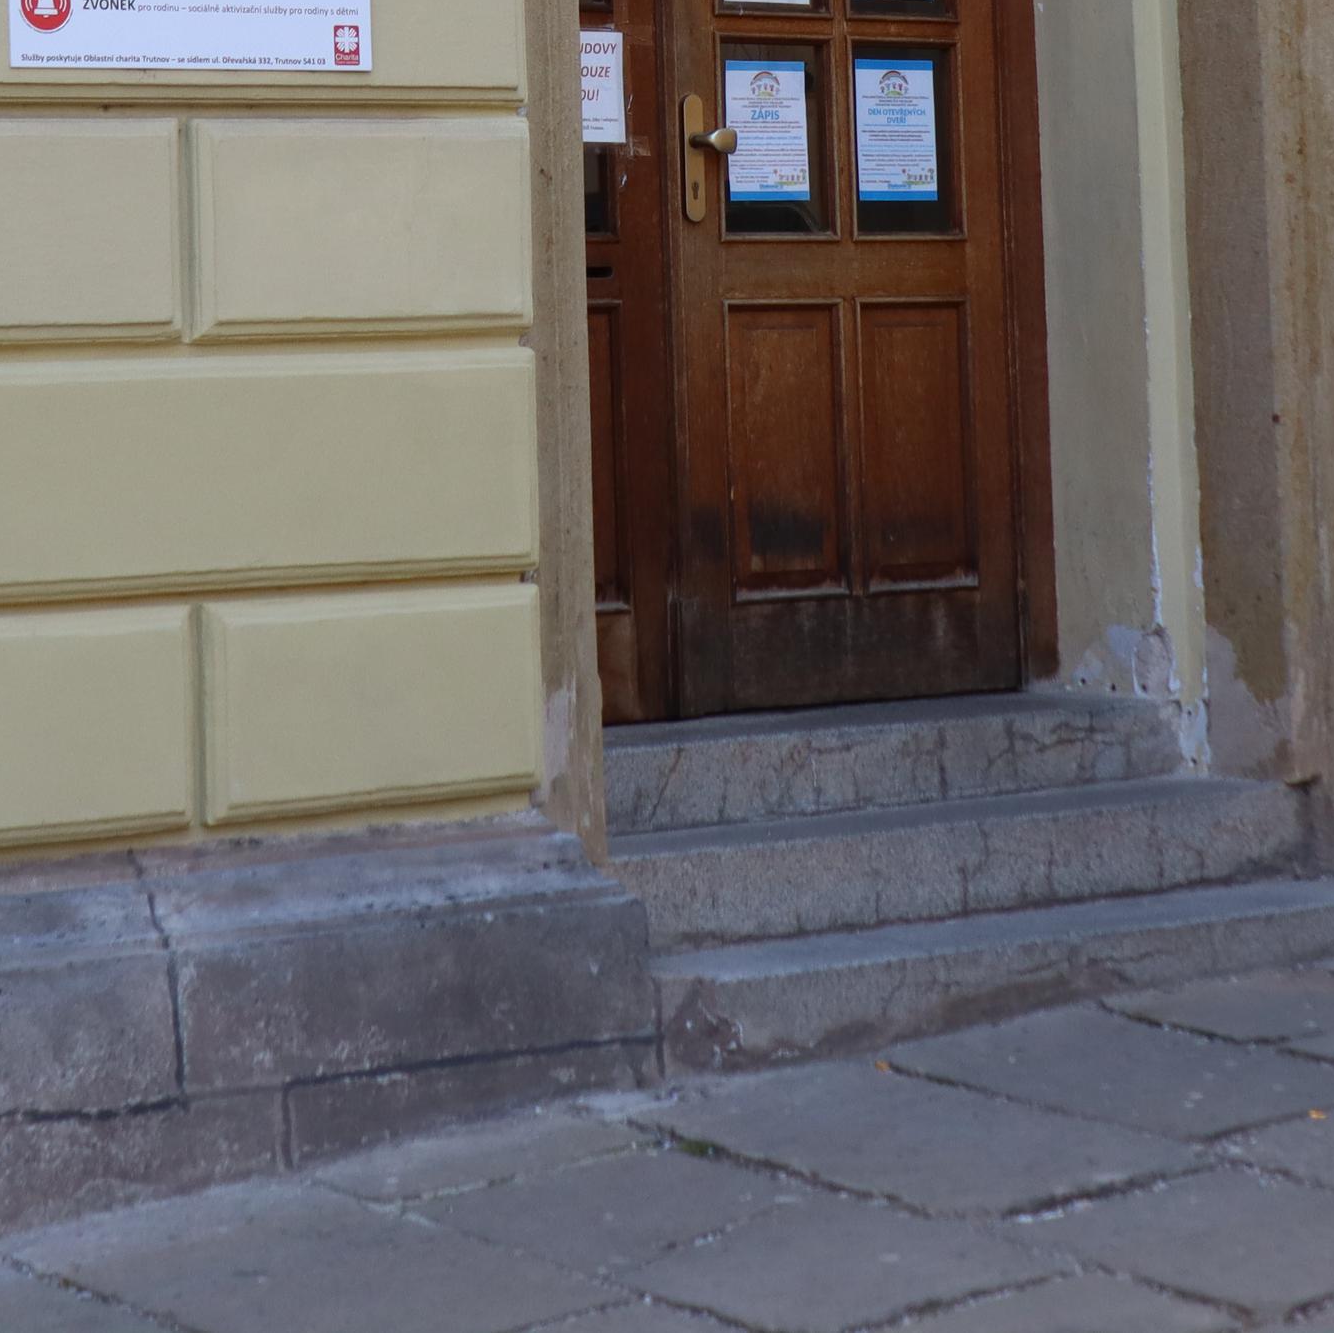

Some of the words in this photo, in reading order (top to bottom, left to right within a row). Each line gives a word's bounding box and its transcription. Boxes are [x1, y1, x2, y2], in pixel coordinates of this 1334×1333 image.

[138, 5, 152, 13] pro
[153, 3, 179, 12] rodinu
[222, 5, 261, 14] aktivizační
[264, 5, 287, 16] služby
[289, 7, 303, 16] pro
[304, 7, 328, 16] rodiny
[336, 7, 359, 16] dětmi
[21, 54, 45, 63] Služby
[46, 54, 82, 63] poskytuje
[84, 54, 114, 63] Oblastní
[142, 55, 170, 63] Trutnov
[187, 56, 210, 64] sídlem
[750, 107, 780, 120] ZÁPIS
